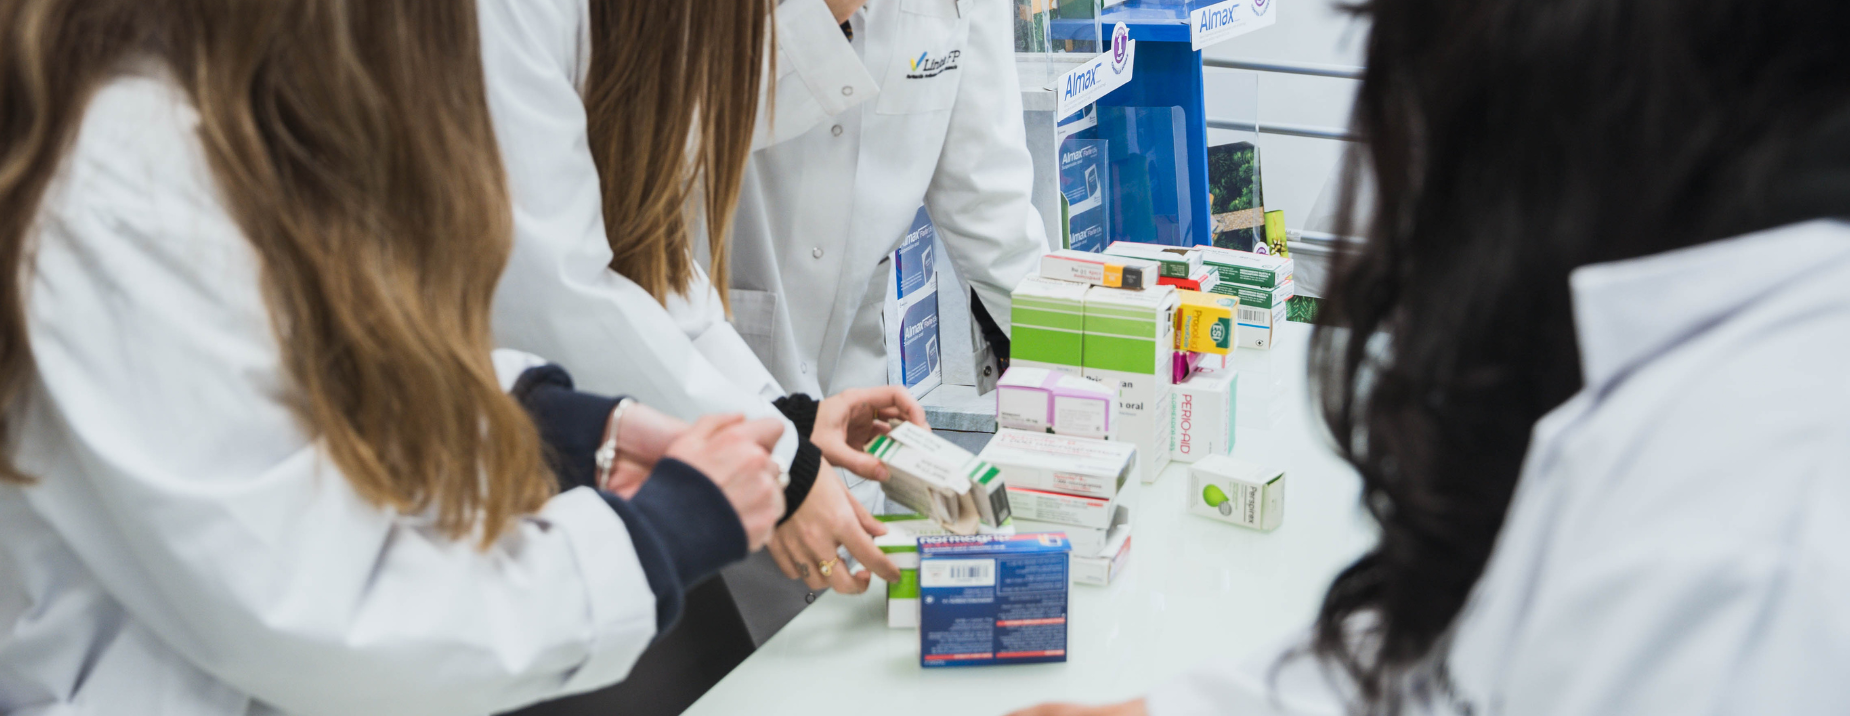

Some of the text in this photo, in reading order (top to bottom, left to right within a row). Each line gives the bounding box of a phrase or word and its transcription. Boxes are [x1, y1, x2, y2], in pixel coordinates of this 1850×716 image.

[1199, 3, 1240, 33] Almax
[947, 49, 961, 63] FP
[1064, 62, 1102, 101] Almax
[1061, 148, 1083, 164] Almax
[904, 321, 924, 340] Almax
[1212, 325, 1222, 339] ESI
[1125, 402, 1144, 410] oral
[1180, 393, 1193, 455] PERIO-AID
[1247, 485, 1258, 524] Perspirex
